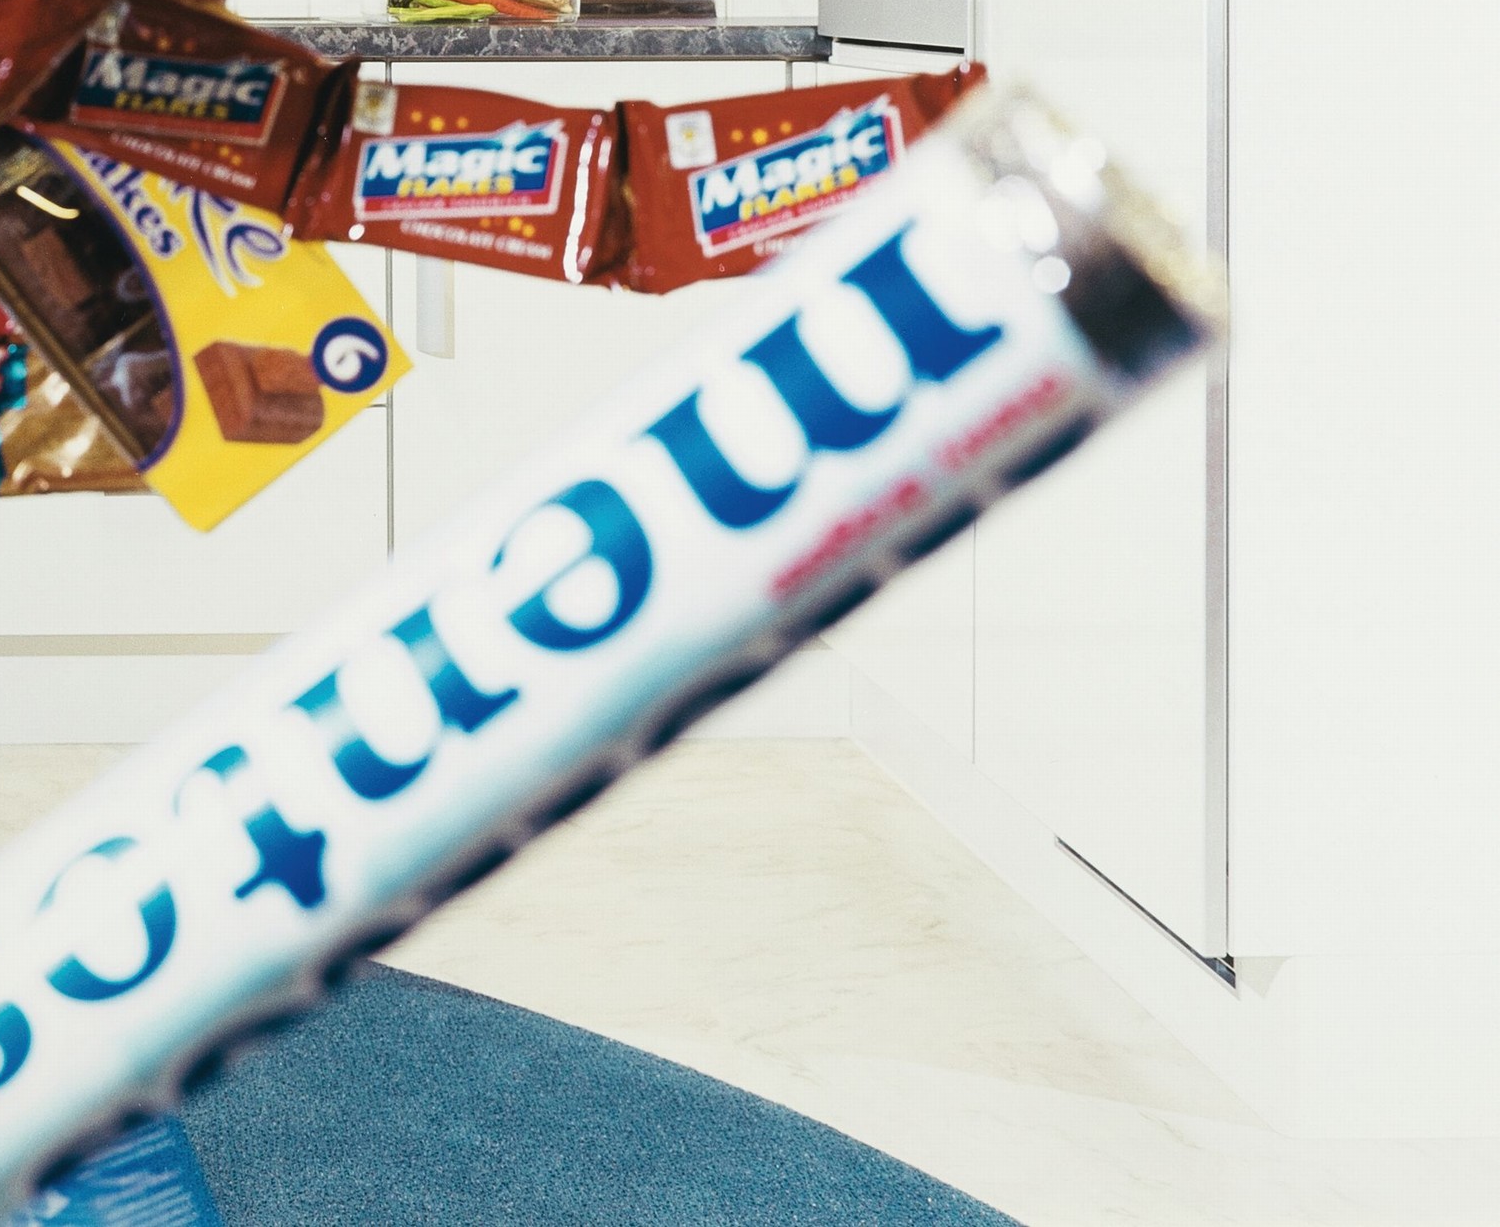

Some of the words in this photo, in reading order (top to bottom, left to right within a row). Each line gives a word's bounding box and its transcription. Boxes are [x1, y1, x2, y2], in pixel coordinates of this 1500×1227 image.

[85, 48, 270, 107] Magic
[113, 89, 231, 118] FLAKES
[365, 123, 550, 183] Magic
[701, 107, 886, 215] Magic
[396, 174, 516, 199] FLAKES
[739, 164, 860, 223] FLAKES
[322, 334, 381, 383] 6
